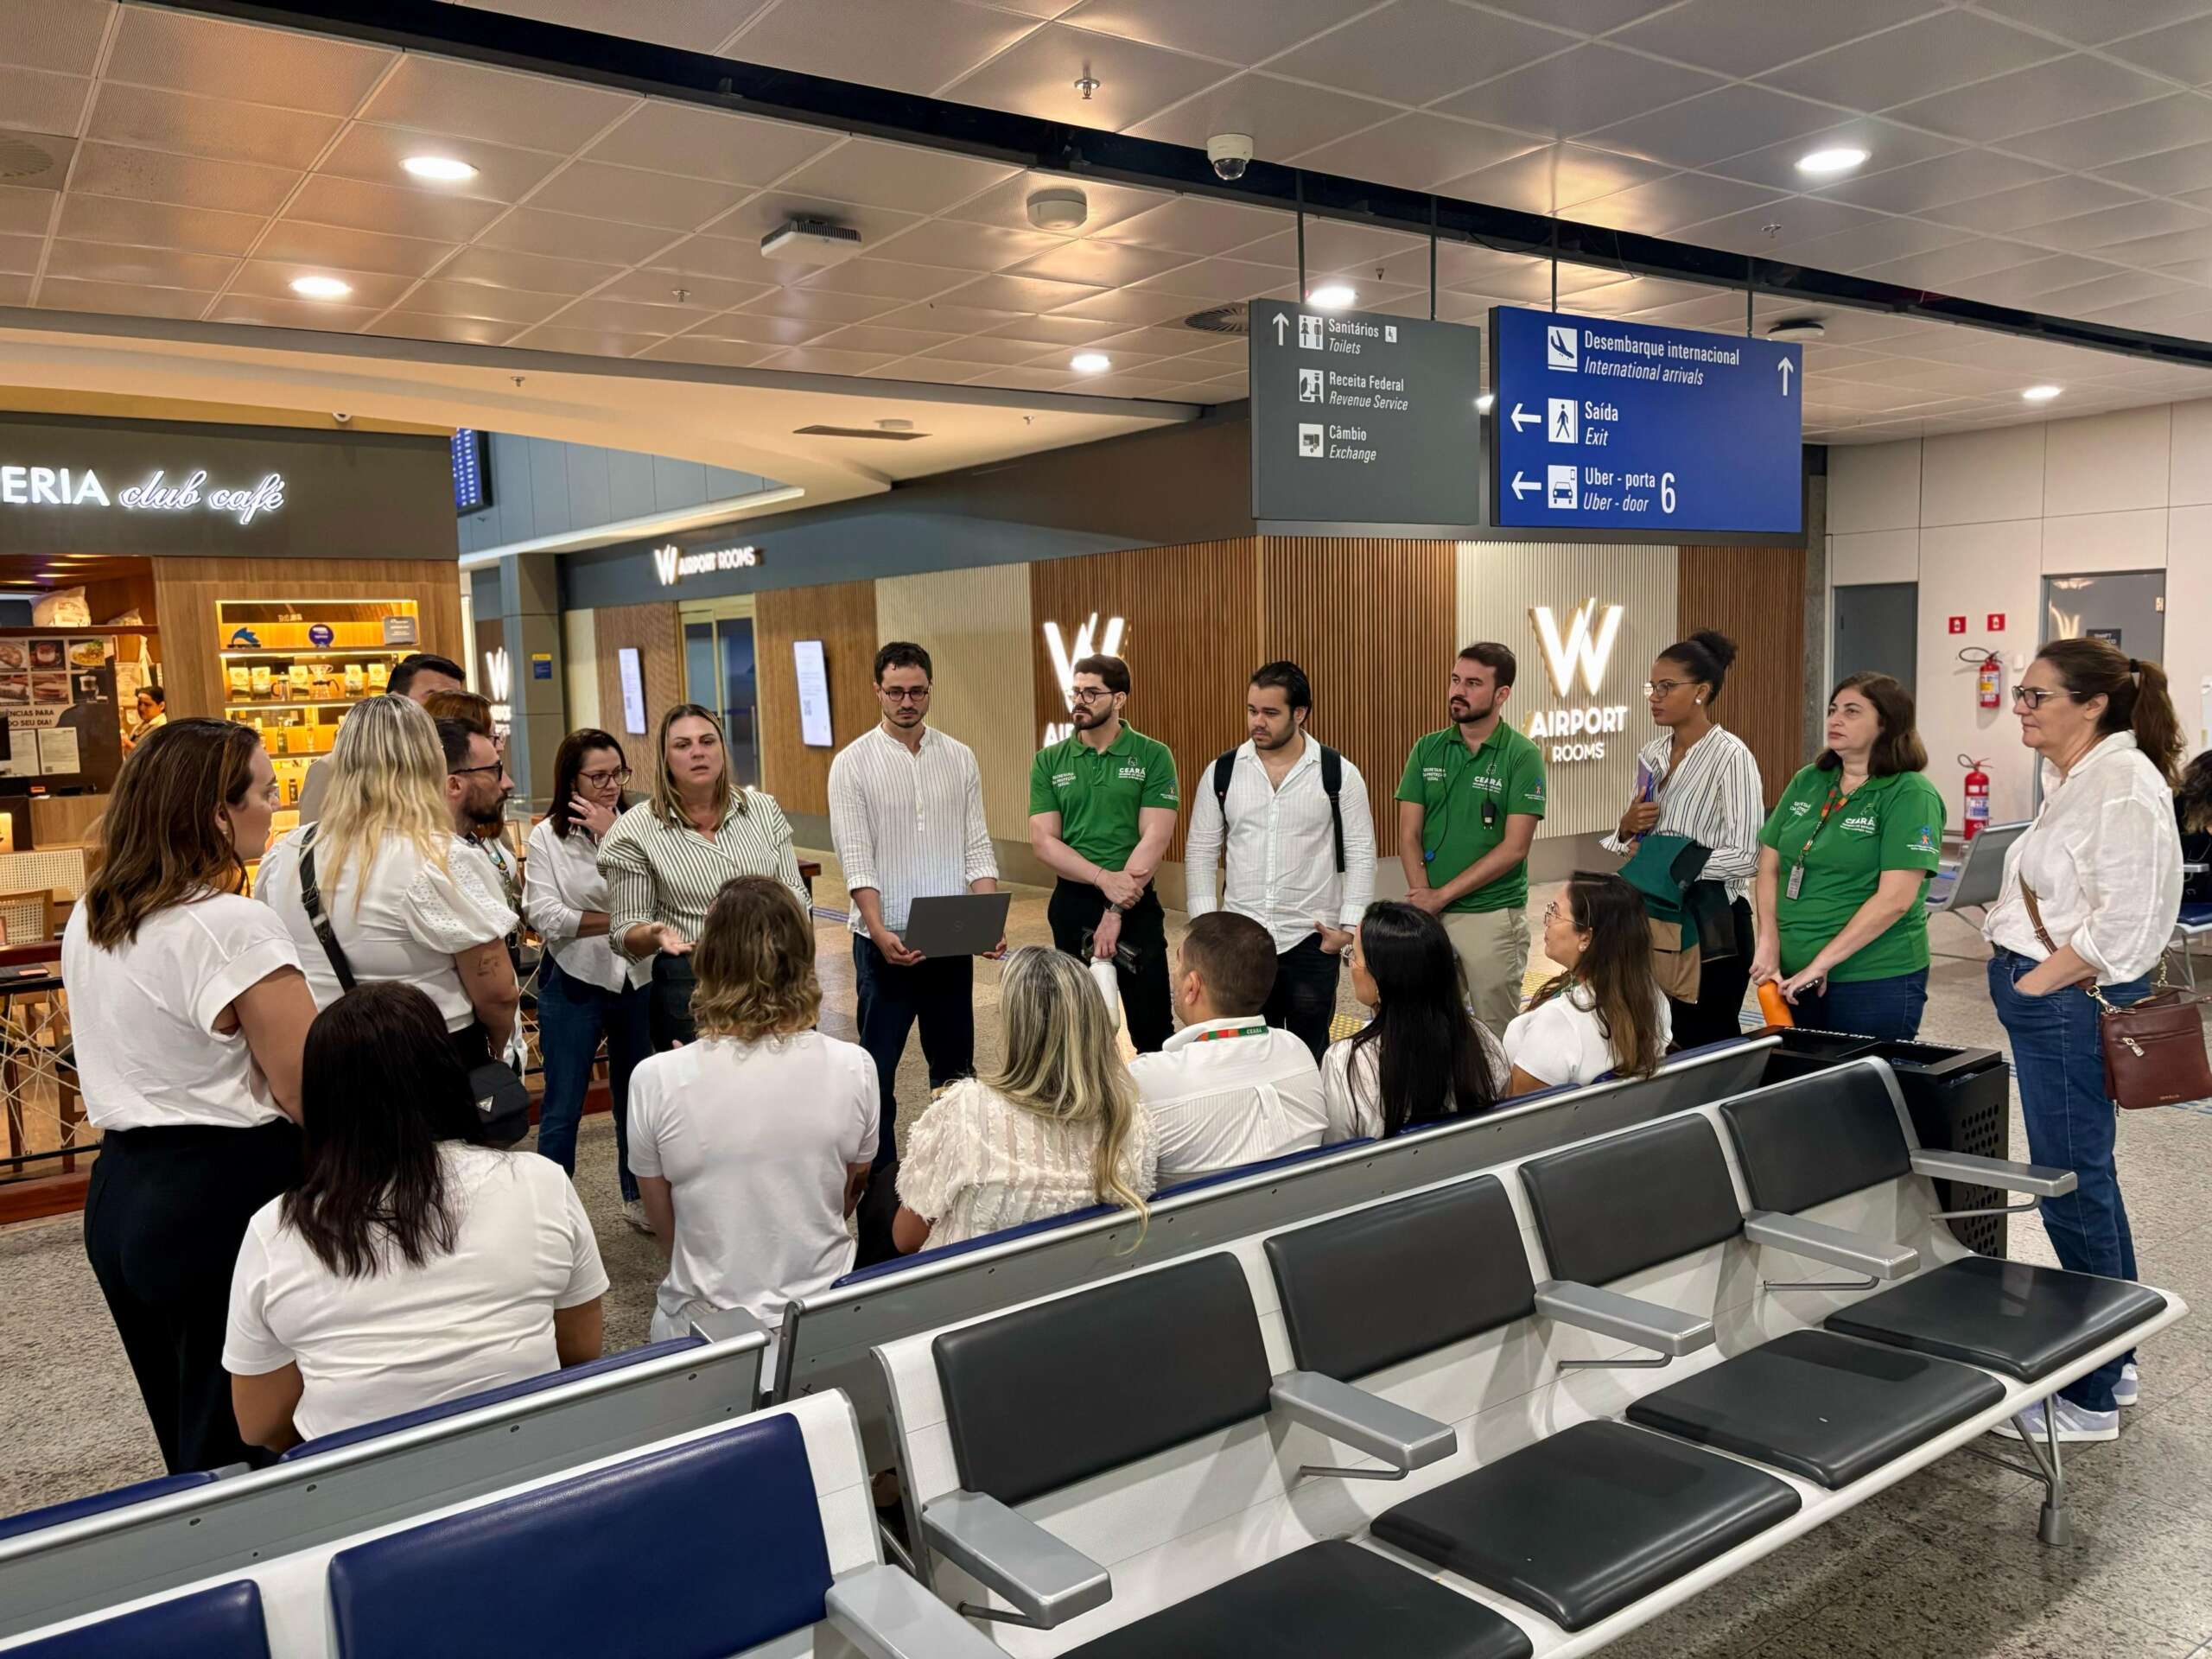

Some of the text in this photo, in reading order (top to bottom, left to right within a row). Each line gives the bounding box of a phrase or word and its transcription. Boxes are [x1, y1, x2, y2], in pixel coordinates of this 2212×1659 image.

[1329, 318, 1379, 338] Sanitários
[1329, 337, 1362, 354] Toilets
[1584, 330, 1739, 365] Desembarque internacional
[1584, 356, 1704, 385] International arrivals
[1329, 371, 1404, 391] Receita Federal
[1329, 391, 1408, 410] Revenue Service
[1585, 401, 1618, 422] Saída
[1329, 424, 1367, 442] Câmbio
[1585, 427, 1609, 446] Exit
[1329, 444, 1376, 463] Exchange
[1585, 467, 1614, 486] Uber
[1625, 473, 1656, 491] porta
[119, 470, 207, 510] club
[209, 474, 285, 525] café
[1583, 492, 1613, 511] Uber
[1622, 493, 1649, 512] door
[1661, 472, 1676, 514] 6
[677, 552, 716, 575] AIRPORT
[718, 546, 756, 569] ROOMS
[1535, 597, 1624, 698] W
[1529, 705, 1628, 738] AIRPORT
[1552, 742, 1605, 762] ROOMS
